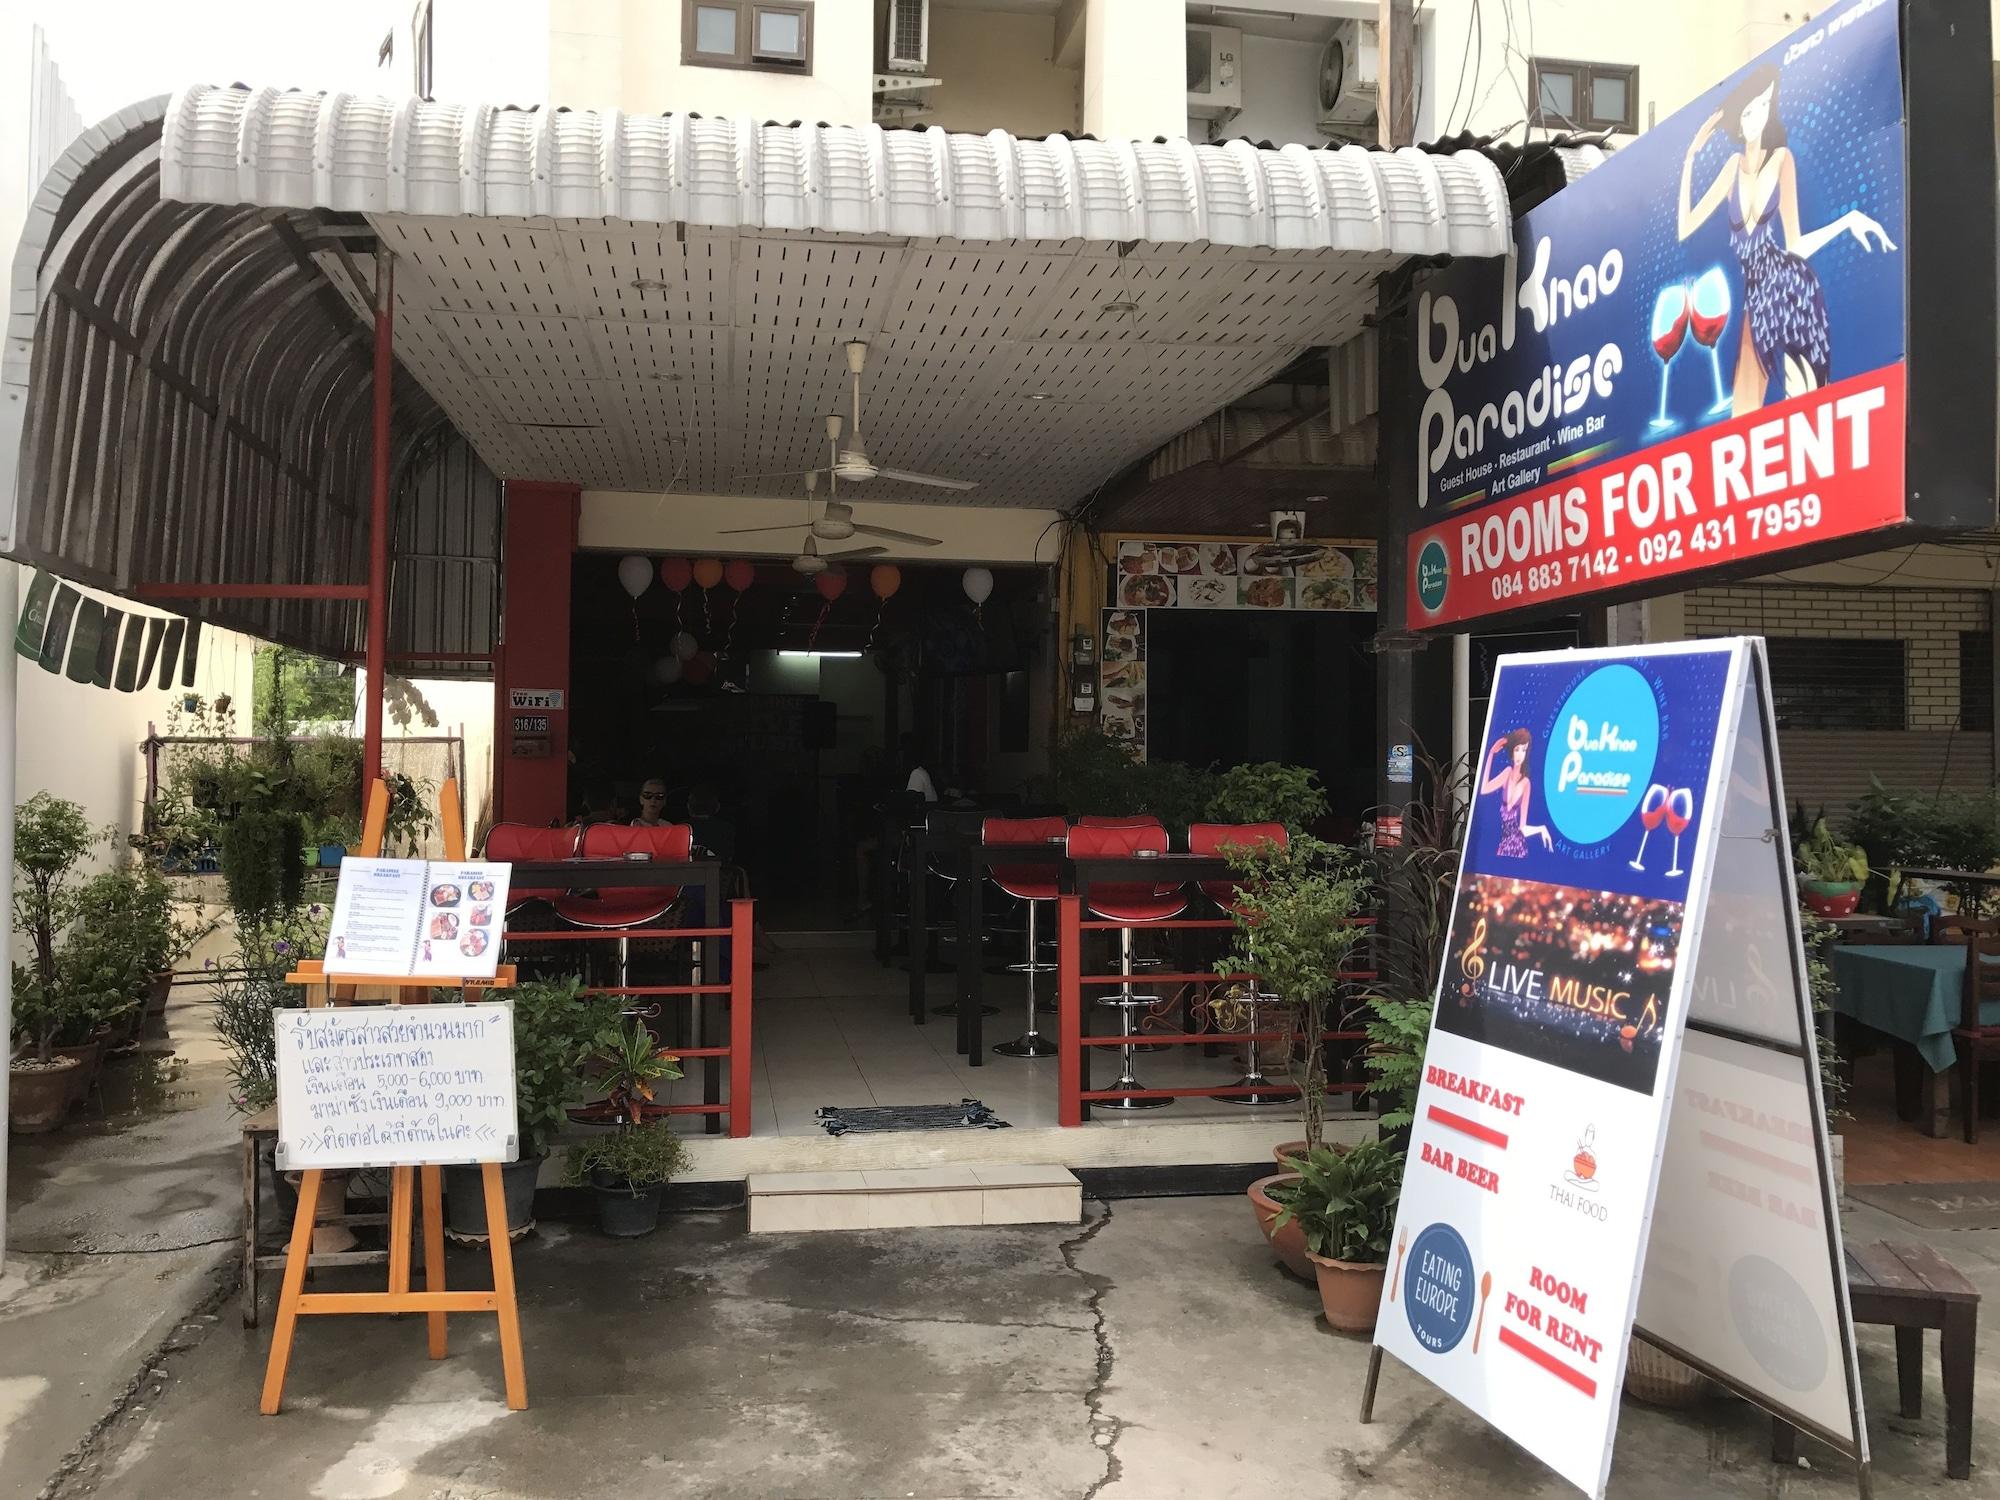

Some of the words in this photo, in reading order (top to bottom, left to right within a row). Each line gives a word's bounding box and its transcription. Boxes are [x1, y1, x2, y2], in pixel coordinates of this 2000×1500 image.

[1219, 52, 1234, 62] LG
[1418, 342, 1623, 509] Paradise
[1440, 473, 1464, 492] Guest
[1465, 464, 1493, 483] House
[1499, 437, 1550, 469] Restaurant
[1557, 425, 1583, 445] Wine
[1586, 415, 1606, 434] Bar
[1461, 486, 1590, 577] ROOMS
[1601, 450, 1699, 538] FOR
[1711, 385, 1886, 508] RENT
[1491, 481, 1506, 496] Art
[1507, 467, 1541, 489] Gallery
[1491, 572, 1523, 601] 084
[1528, 563, 1563, 592] 883
[1567, 547, 1619, 584] 7142
[1639, 530, 1683, 567] 092
[1689, 521, 1737, 554] 431
[1746, 494, 1822, 540] 7959
[512, 696, 550, 707] WiFi
[514, 718, 546, 731] 316/135
[1558, 750, 1631, 793] Paradise
[1555, 839, 1571, 856] ART
[1573, 843, 1611, 860] GALLERY
[1488, 961, 1544, 1000] LIVE
[1549, 976, 1630, 1019] MUSIC
[1426, 1065, 1525, 1116] BREAKFAST
[1420, 1142, 1455, 1173] BAR
[1456, 1157, 1500, 1194] BEER
[1550, 1184, 1574, 1208] THAI
[1576, 1196, 1608, 1222] FOOD
[1421, 1249, 1462, 1292] EATING
[1529, 1266, 1588, 1315] ROOM
[1415, 1276, 1459, 1323] EUROPE
[1416, 1324, 1442, 1348] TOURS
[1504, 1291, 1542, 1331] FOR
[1545, 1314, 1603, 1364] RENT
